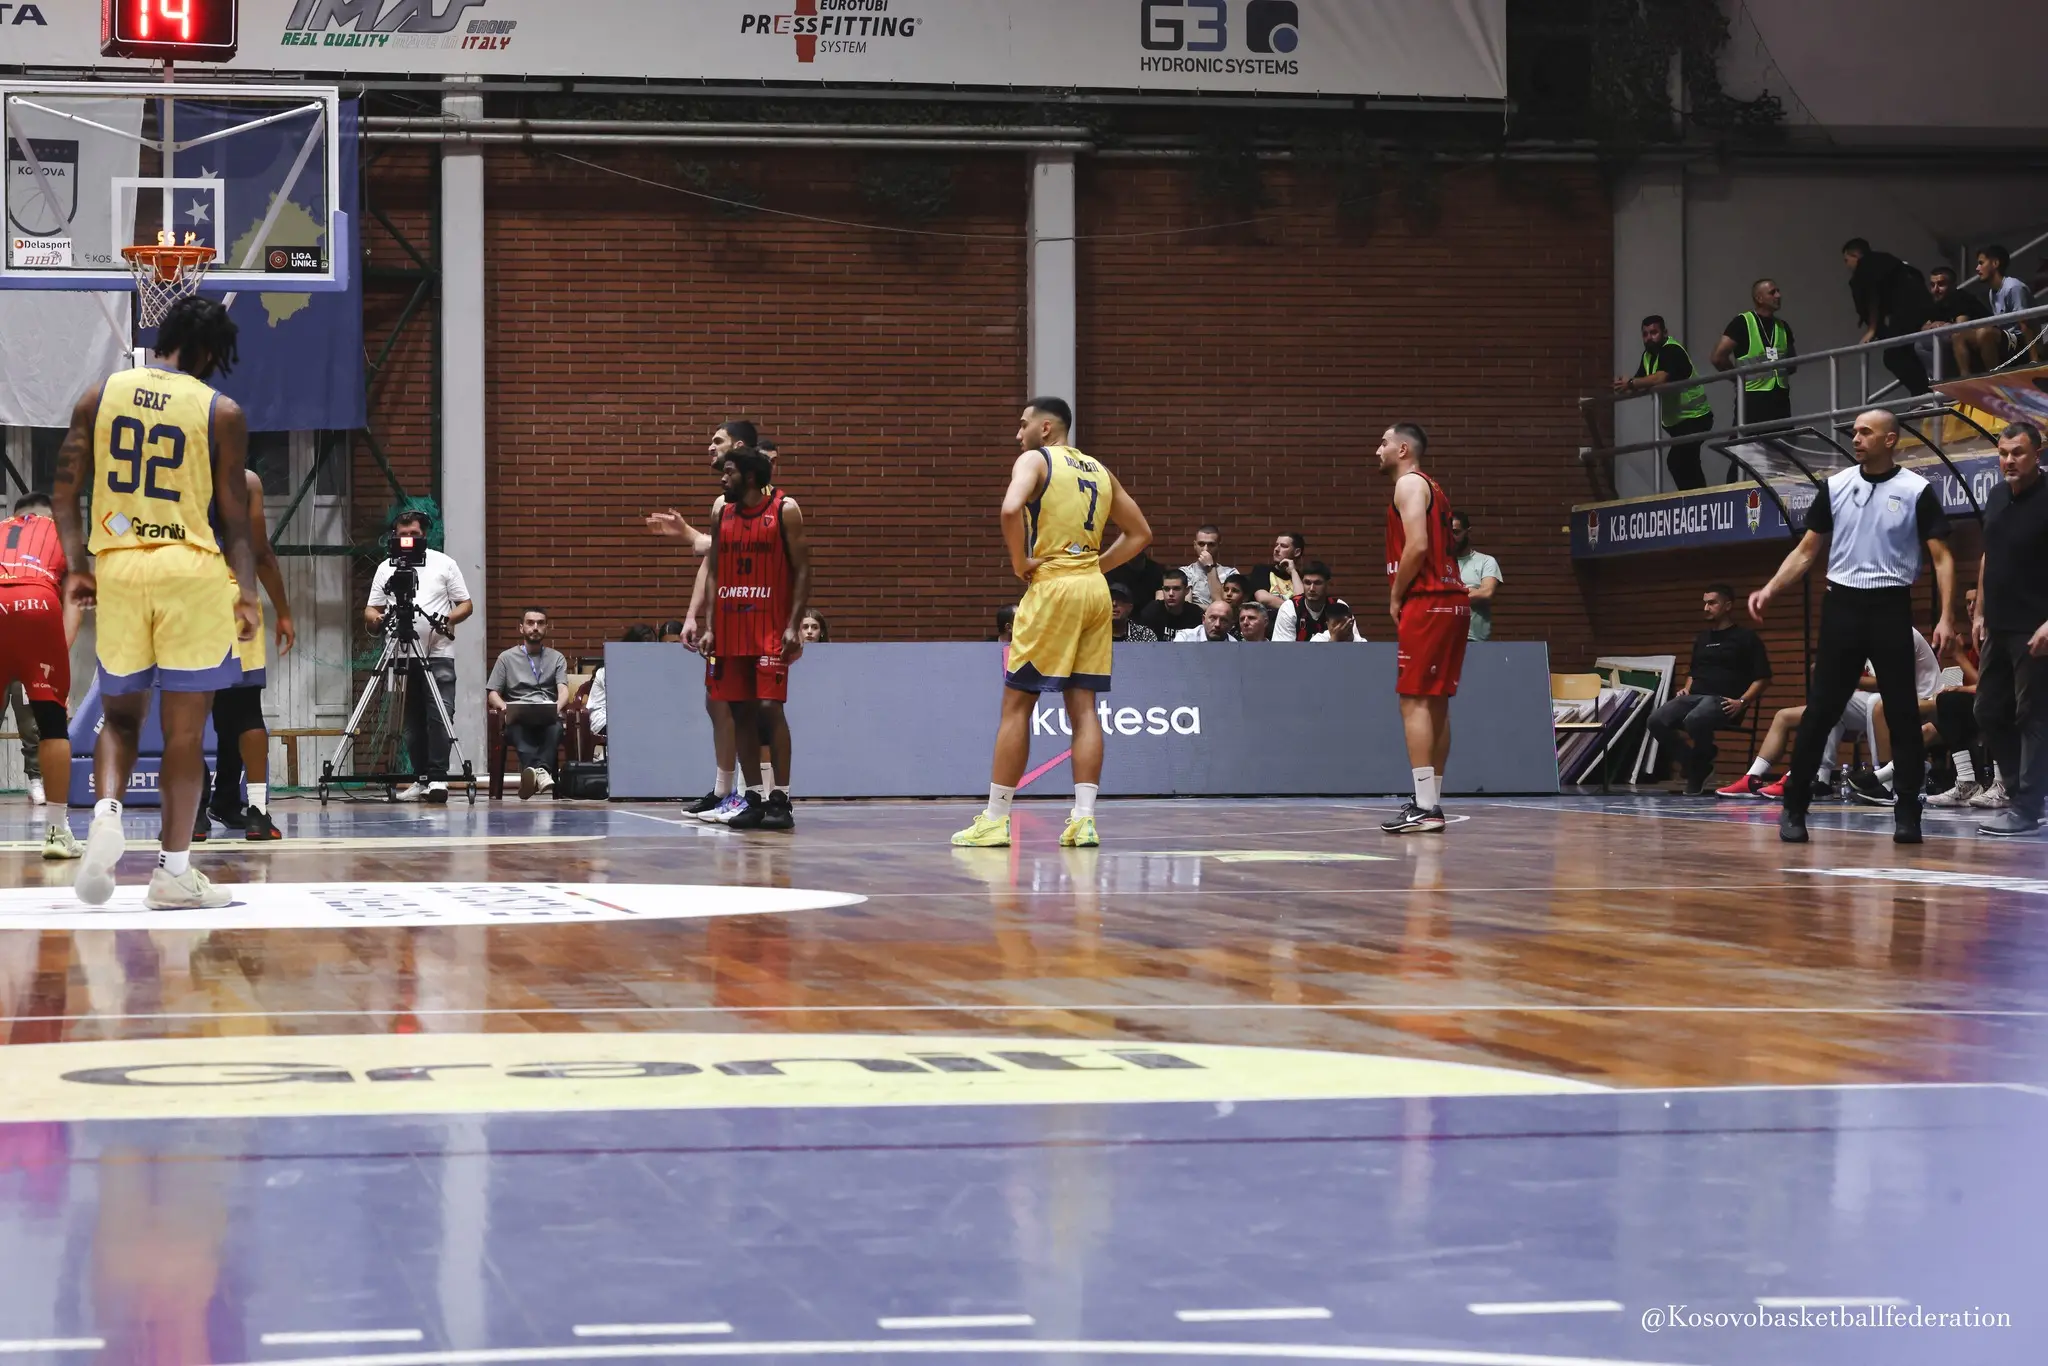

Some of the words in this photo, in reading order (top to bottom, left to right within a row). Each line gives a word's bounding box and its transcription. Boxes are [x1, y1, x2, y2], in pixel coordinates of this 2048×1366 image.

[820, 0, 888, 11] EUROTUBI
[140, 0, 189, 38] 14
[467, 19, 517, 34] GROUP
[1141, 0, 1227, 51] G3
[281, 32, 318, 46] REAL
[324, 33, 389, 48] QUALITY
[392, 34, 437, 49] MADE
[440, 35, 458, 49] IN
[461, 36, 511, 50] ITALY
[820, 40, 867, 53] SYSTEM
[1140, 56, 1223, 73] HYDRONIC
[1225, 58, 1299, 75] SYSTEMS
[18, 166, 65, 177] KOOVA
[24, 240, 71, 250] Delasport
[291, 252, 311, 260] LIGA
[291, 260, 318, 268] UNIKE
[133, 388, 171, 411] GRAF
[108, 415, 186, 502] 92
[1077, 477, 1098, 531] 7
[131, 517, 186, 540] Graniti
[1610, 516, 1628, 541] K.B.
[1630, 510, 1671, 540] GOLDEN
[1673, 504, 1708, 535] EAGLE
[1710, 501, 1734, 531] YLLI
[1031, 699, 1201, 736] kutesa
